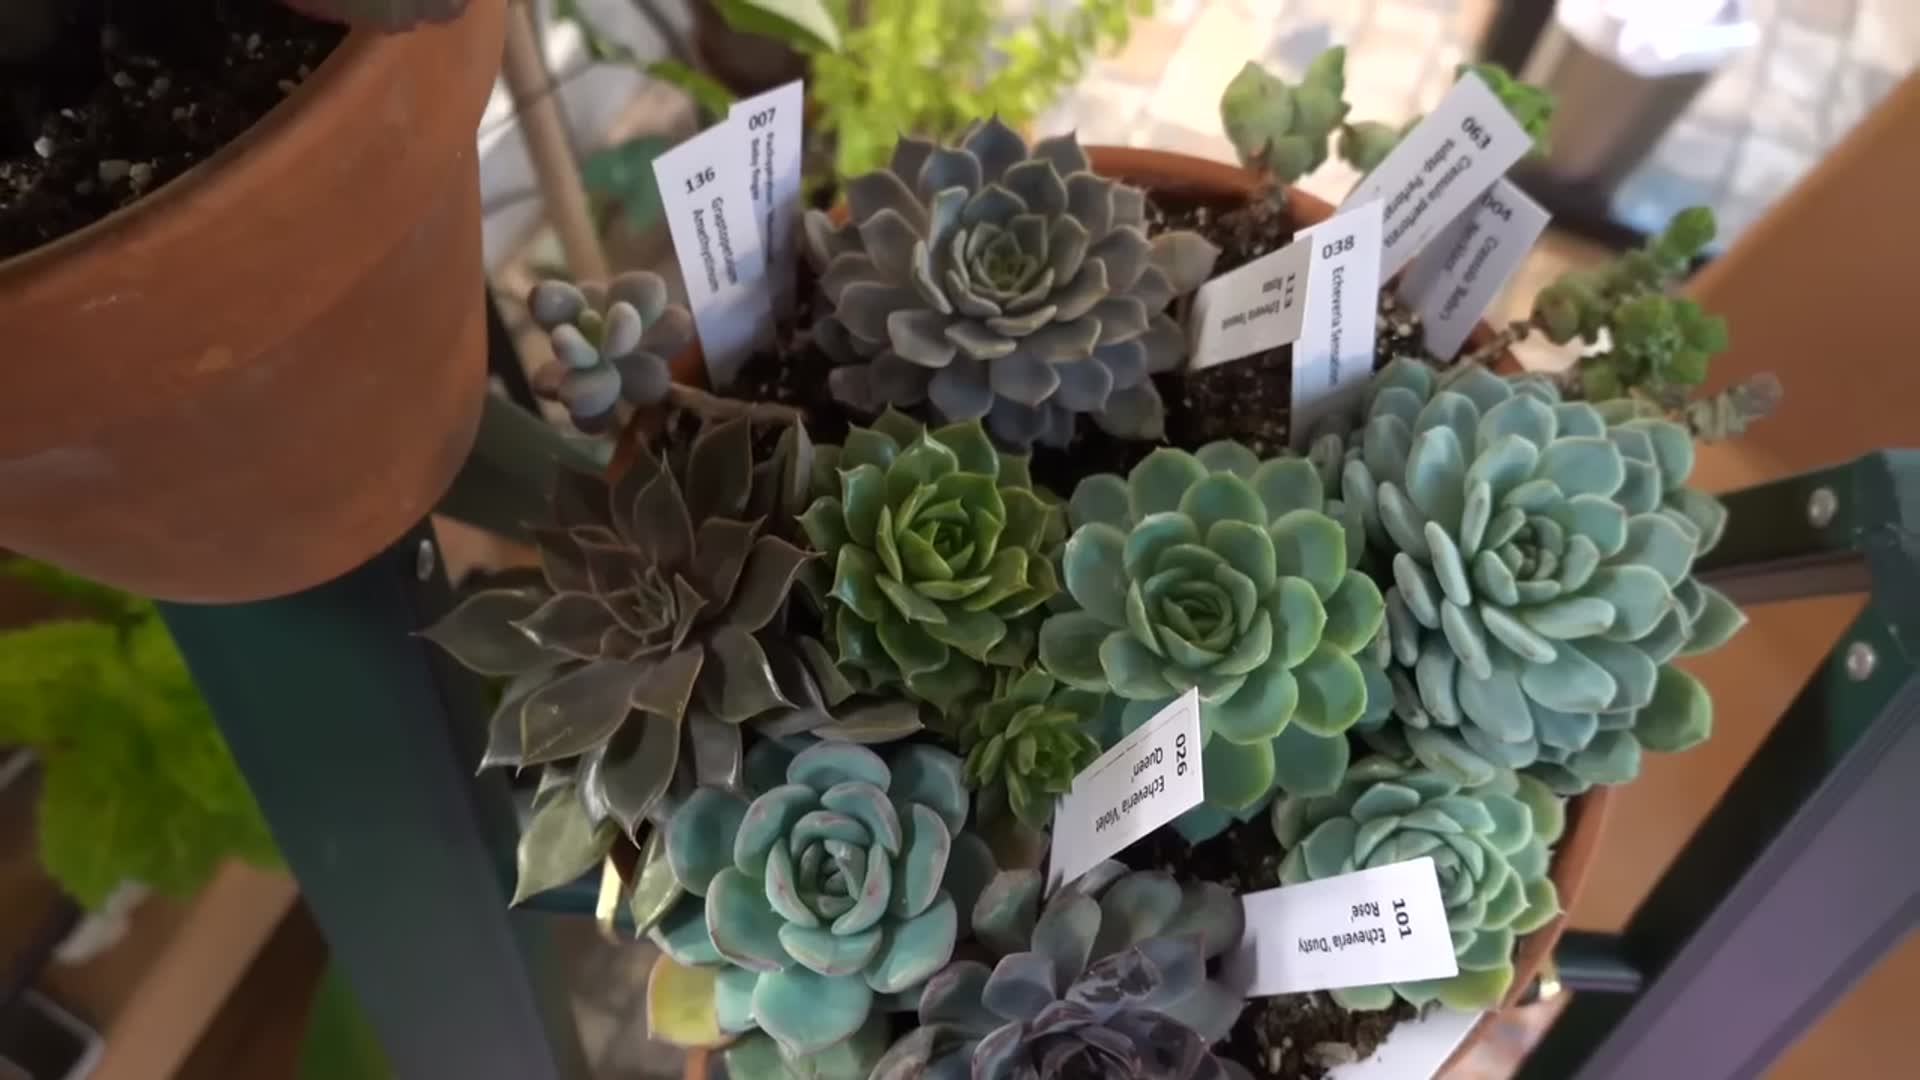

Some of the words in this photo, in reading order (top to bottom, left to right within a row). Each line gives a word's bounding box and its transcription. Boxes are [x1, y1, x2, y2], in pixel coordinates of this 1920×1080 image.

[748, 107, 777, 131] 007
[1461, 116, 1493, 150] 063
[684, 166, 716, 194] 136
[1427, 154, 1473, 202] Crassula
[1382, 176, 1425, 224] Perforat
[1322, 234, 1355, 260] 038
[1331, 265, 1345, 326] Echeveria
[1130, 747, 1163, 783] Queen'
[1175, 733, 1188, 777] 026
[1122, 775, 1164, 813] Echeveria
[1350, 901, 1379, 921] Rose'
[1392, 898, 1412, 939] 101
[1298, 936, 1332, 953] 'Dusty
[1332, 927, 1387, 948] Echeveria
